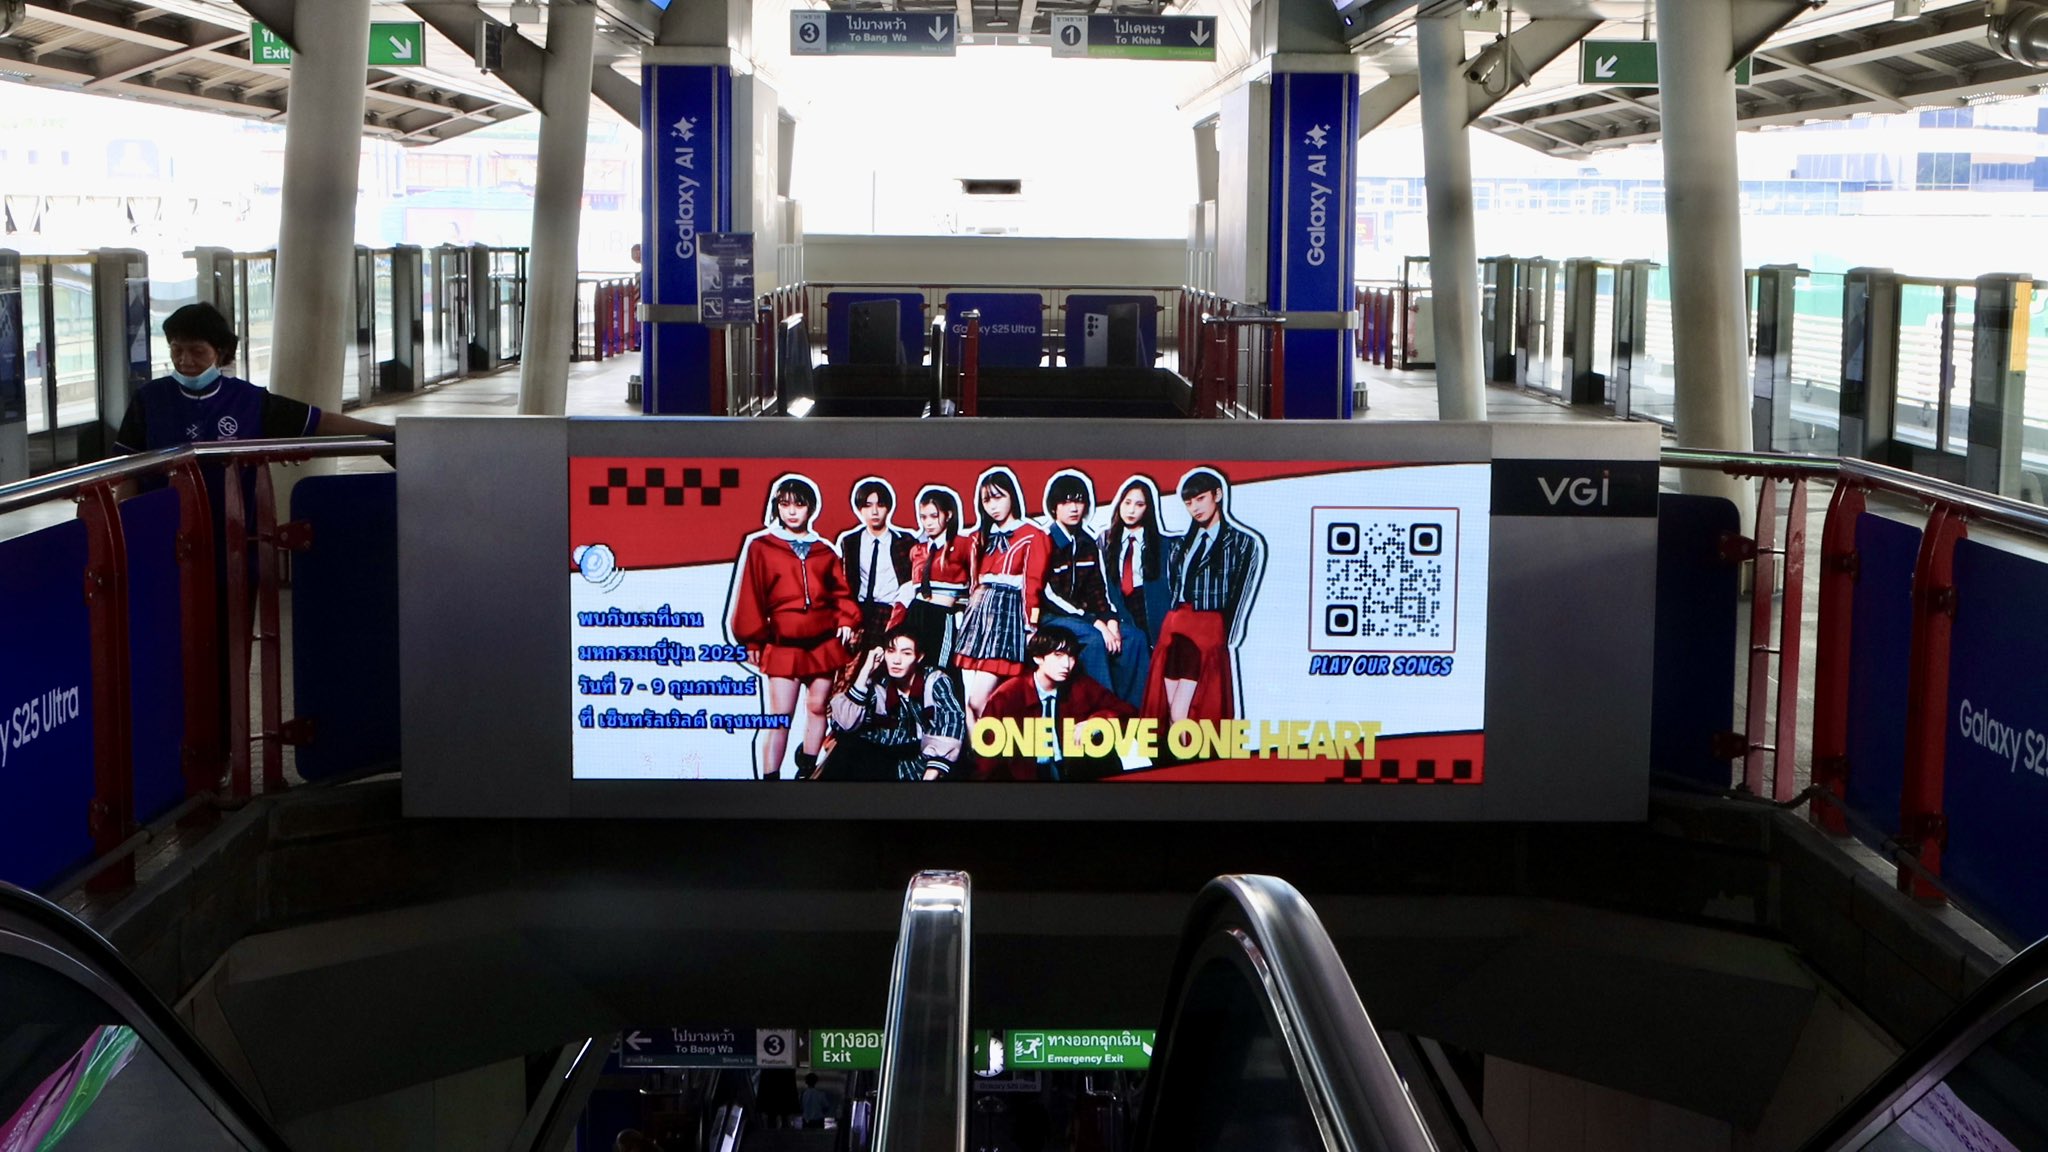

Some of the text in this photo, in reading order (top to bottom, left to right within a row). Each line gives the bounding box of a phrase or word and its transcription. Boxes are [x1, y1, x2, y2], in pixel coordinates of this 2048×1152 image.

[845, 15, 907, 31] ไปบางหว้า
[803, 24, 816, 42] 3
[849, 33, 907, 44] To Bang Wa
[1064, 26, 1075, 44] 1
[1114, 36, 1162, 45] To Kheha
[262, 46, 290, 60] Exit
[675, 147, 700, 260] Galaxy AI
[1306, 154, 1333, 267] Galaxy AI
[952, 323, 1036, 336] Gaxy S25 Ultra
[577, 603, 705, 628] พบกับเราที่งาน
[577, 637, 748, 667] มหกรรมญี่ปุ่น 2025
[1309, 656, 1454, 677] PLAY OUR SONGS
[577, 671, 617, 696] วันที่
[619, 677, 634, 696] 7
[650, 677, 666, 695] 9
[668, 674, 757, 701] กุมภาพันธ์
[12, 697, 40, 750] S25
[42, 685, 80, 733] Ultra
[577, 704, 792, 735] ที่ เซ็นทรัลเวิลด์ กรุงเทพฯ
[971, 716, 1382, 761] ONE LOVE ONE HEART
[1959, 698, 2048, 778] Galaxy S2
[671, 1027, 736, 1043] ไปบางหว้า
[1046, 1030, 1142, 1052] ทางออกฉุกเฉิน
[675, 1045, 734, 1055] To Bang Wa
[768, 1036, 781, 1054] 3
[822, 1050, 852, 1064] Exit
[1047, 1054, 1124, 1066] Emergency Exit
